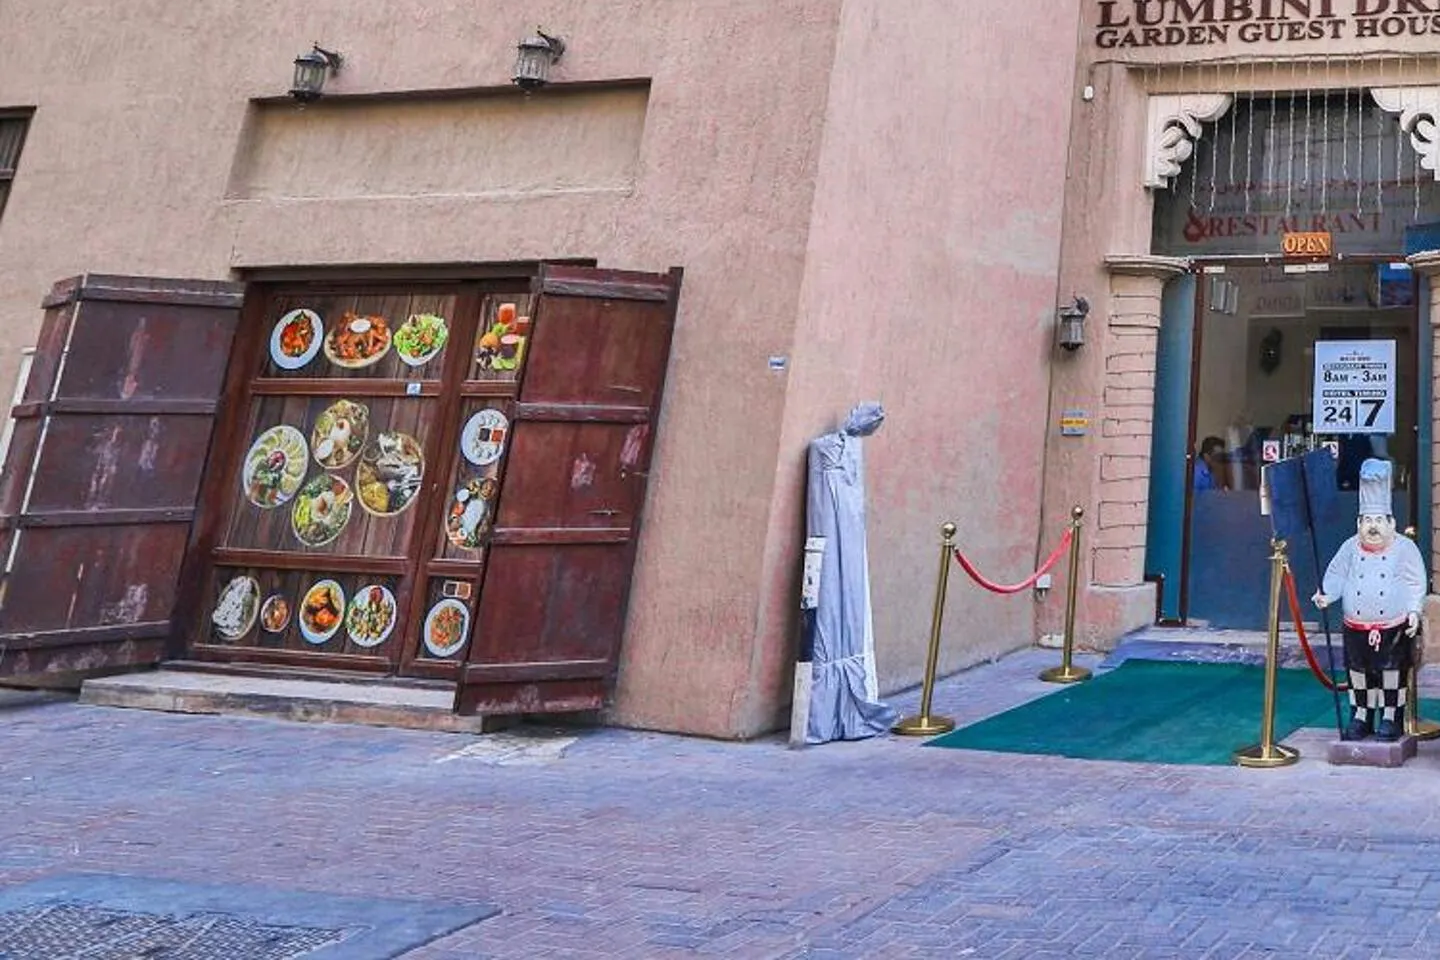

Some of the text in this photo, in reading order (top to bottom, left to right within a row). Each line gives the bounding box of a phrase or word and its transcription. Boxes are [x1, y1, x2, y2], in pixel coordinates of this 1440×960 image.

[1095, 24, 1231, 49] GARDEN
[1238, 19, 1347, 45] GUEST
[1283, 235, 1330, 253] OPEN
[1324, 399, 1385, 427] 24 7
